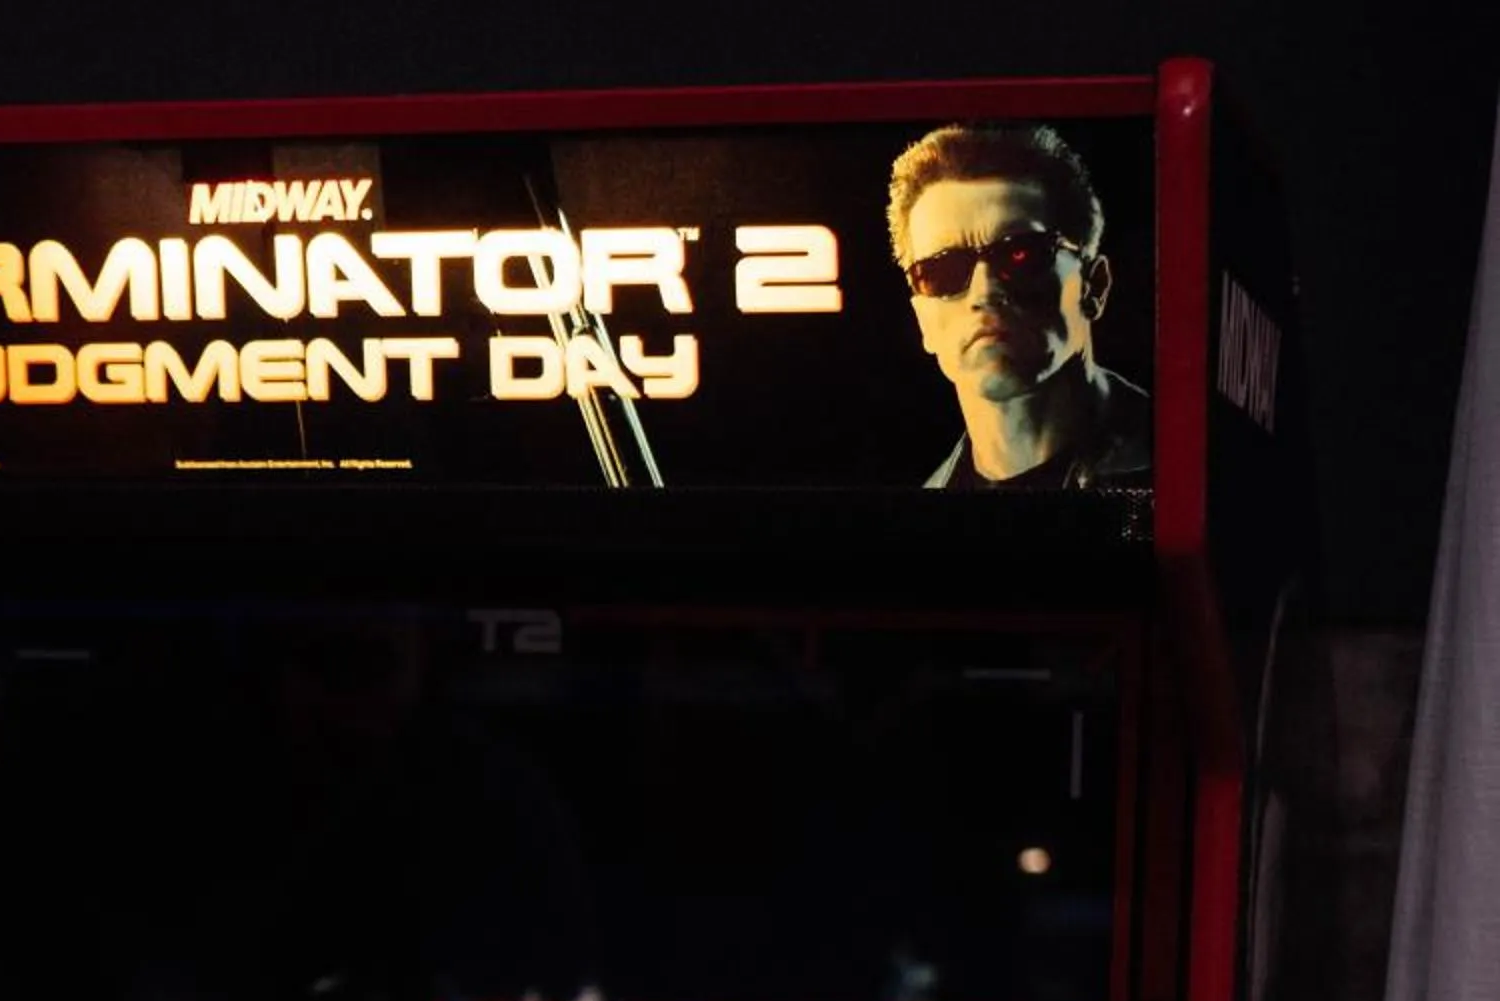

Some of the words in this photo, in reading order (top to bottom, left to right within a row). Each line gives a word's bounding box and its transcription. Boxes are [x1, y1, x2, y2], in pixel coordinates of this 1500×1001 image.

[735, 224, 842, 313] 2
[489, 333, 699, 400] DAY
[466, 607, 562, 653] T2
